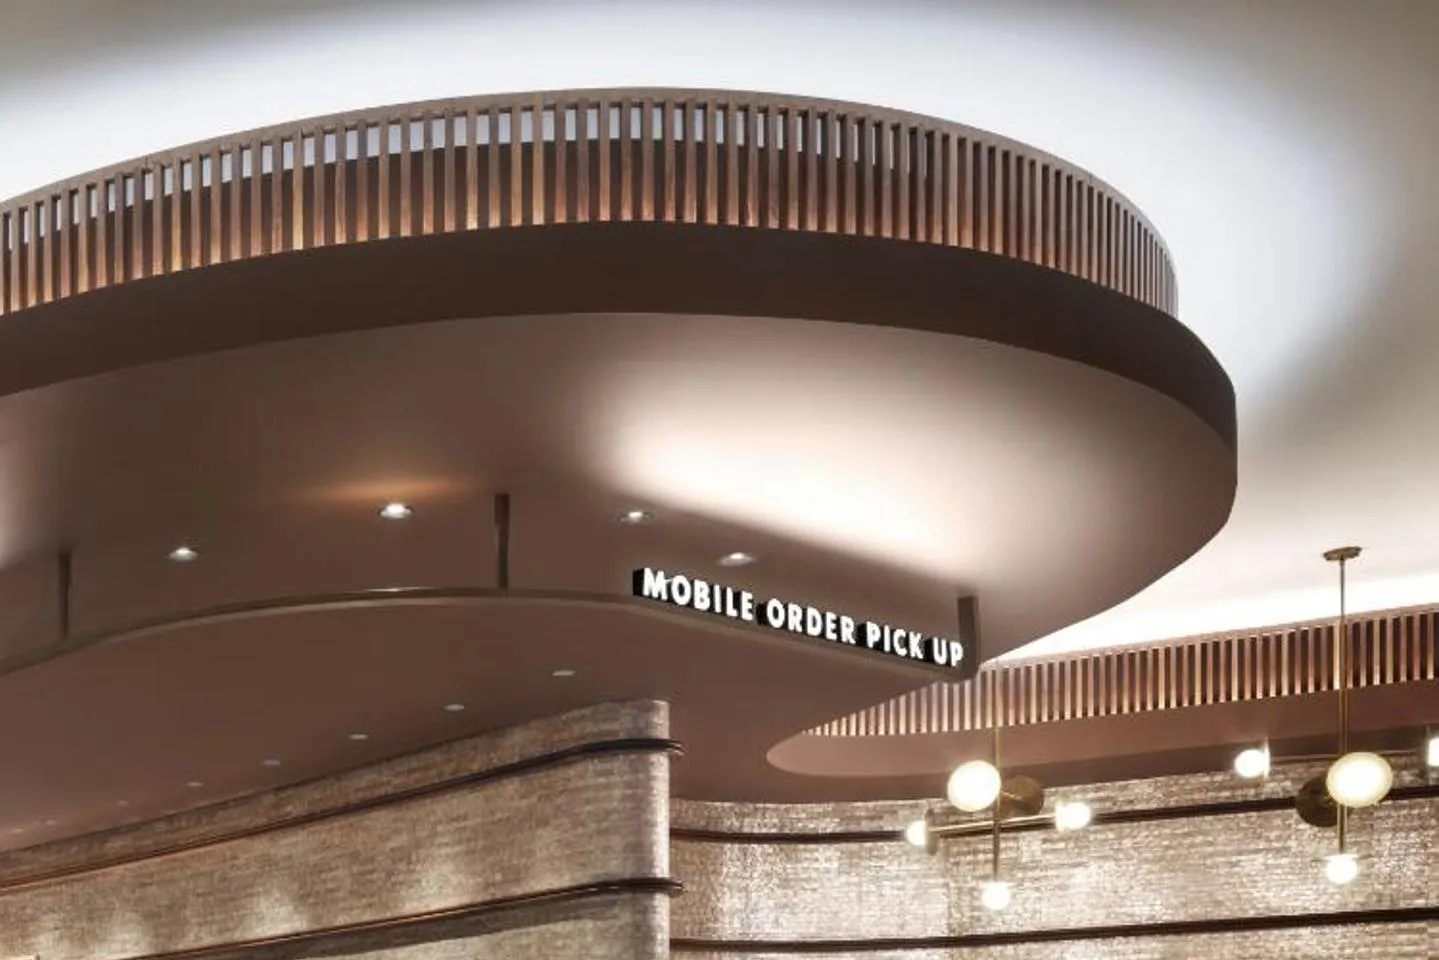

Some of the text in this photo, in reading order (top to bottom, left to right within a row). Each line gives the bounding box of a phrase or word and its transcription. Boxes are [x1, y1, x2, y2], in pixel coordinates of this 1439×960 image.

[642, 567, 964, 667] MOBILE ORDER PICK UP
